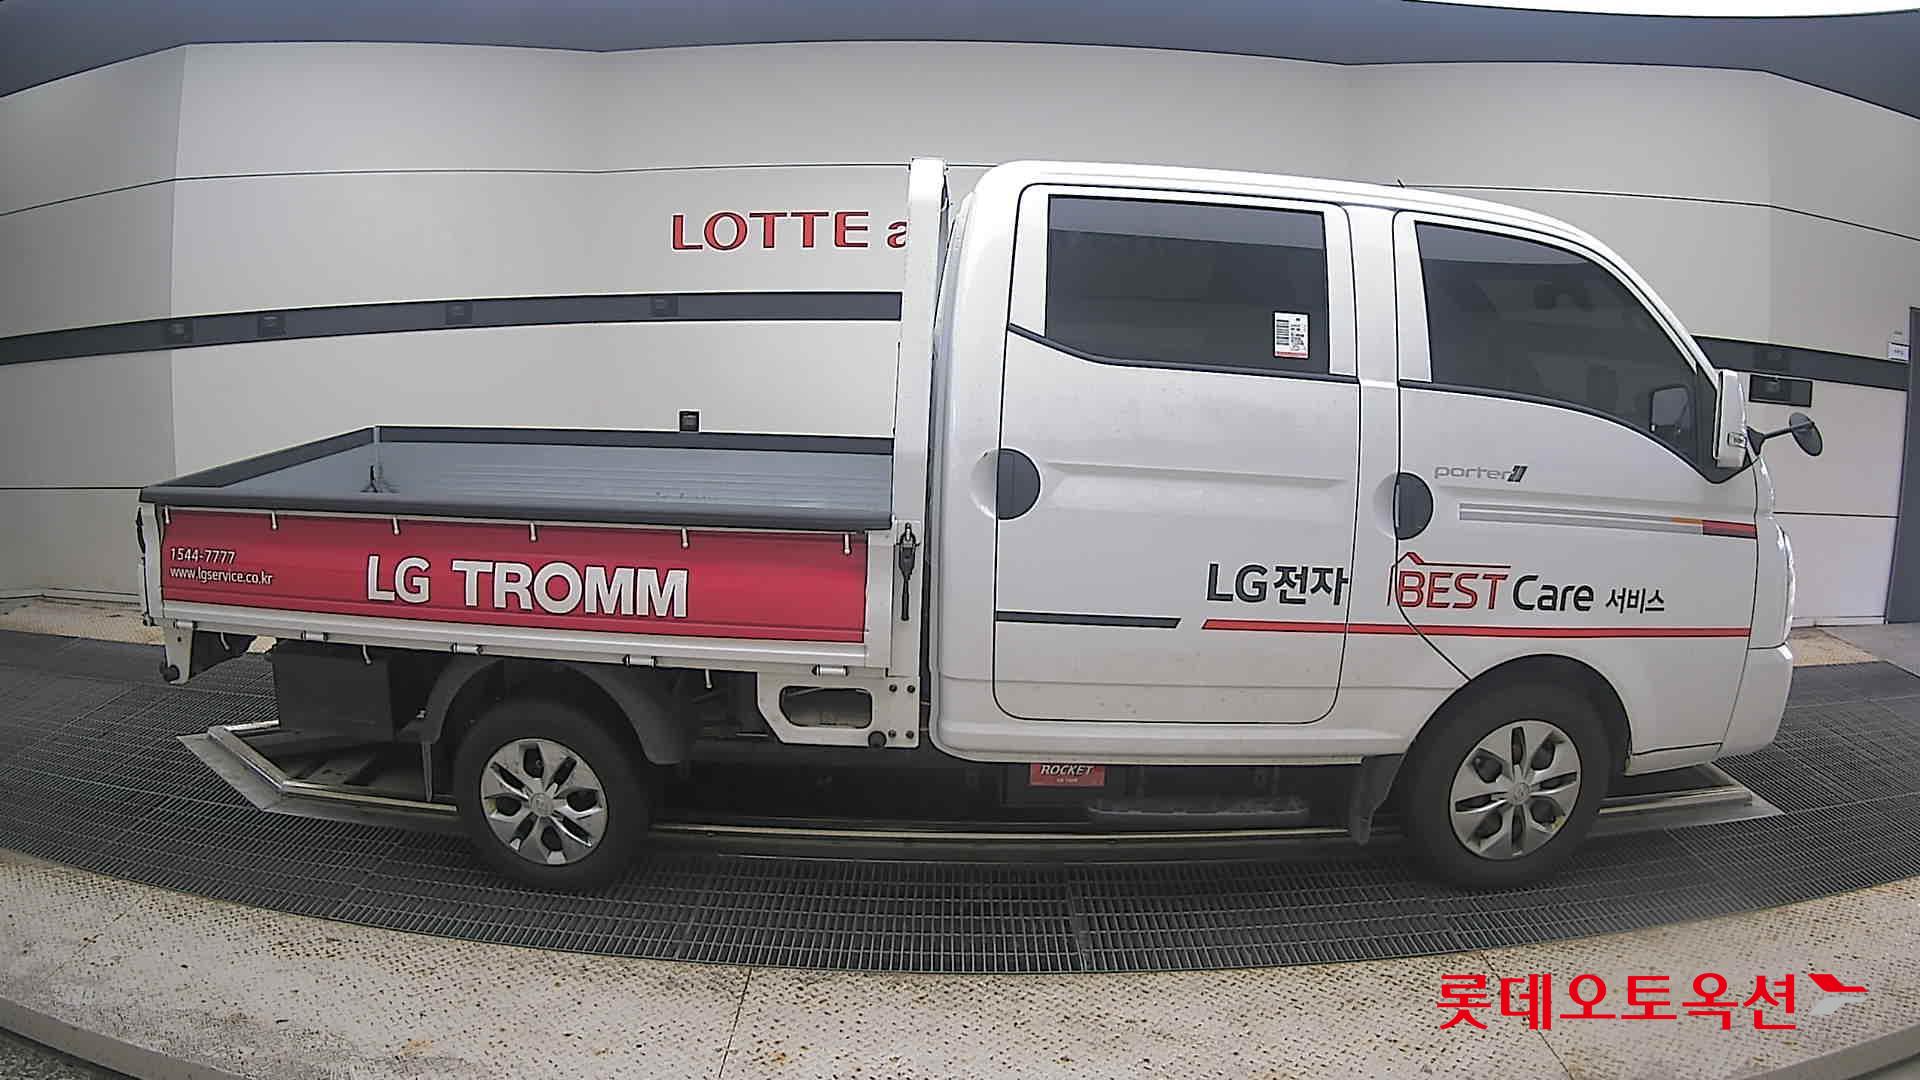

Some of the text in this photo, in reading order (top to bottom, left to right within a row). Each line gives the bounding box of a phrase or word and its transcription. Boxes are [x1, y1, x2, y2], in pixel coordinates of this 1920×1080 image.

[672, 211, 869, 251] LOTTE
[170, 547, 236, 565] 1544-7777
[169, 565, 273, 586] www.lgservice.co.kr
[367, 555, 688, 618] LG TROMM
[1399, 570, 1508, 609] BEST
[1512, 574, 1594, 611] Care
[1605, 587, 1665, 614] 서비스
[1039, 763, 1095, 777] ROCKET
